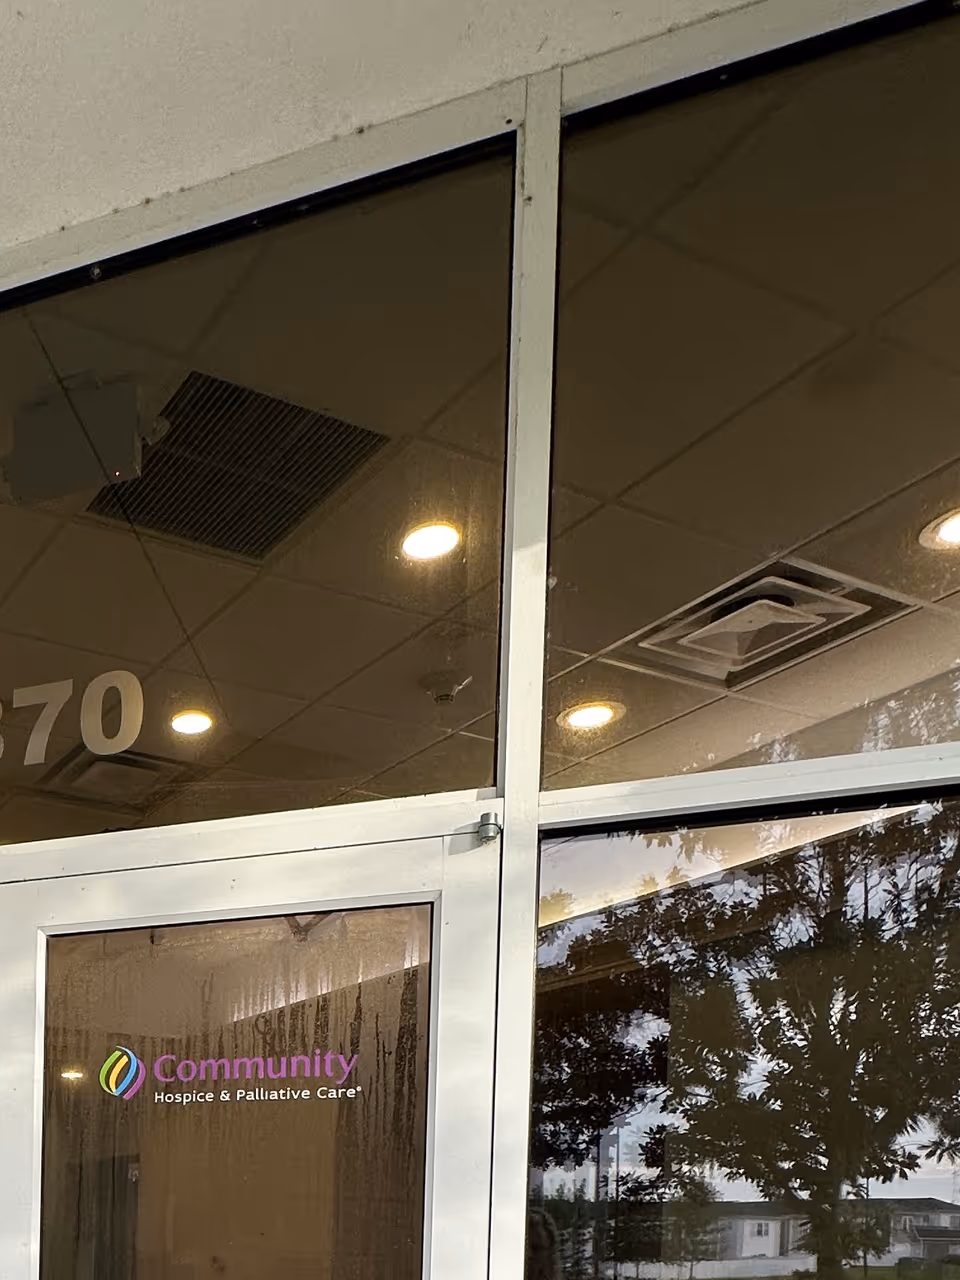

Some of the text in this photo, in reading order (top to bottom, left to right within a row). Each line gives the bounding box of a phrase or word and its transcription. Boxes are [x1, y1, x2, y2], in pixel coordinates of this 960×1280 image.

[153, 1049, 358, 1085] Community
[154, 1090, 215, 1106] Hospice
[219, 1090, 231, 1102] &
[236, 1086, 311, 1101] Palliative
